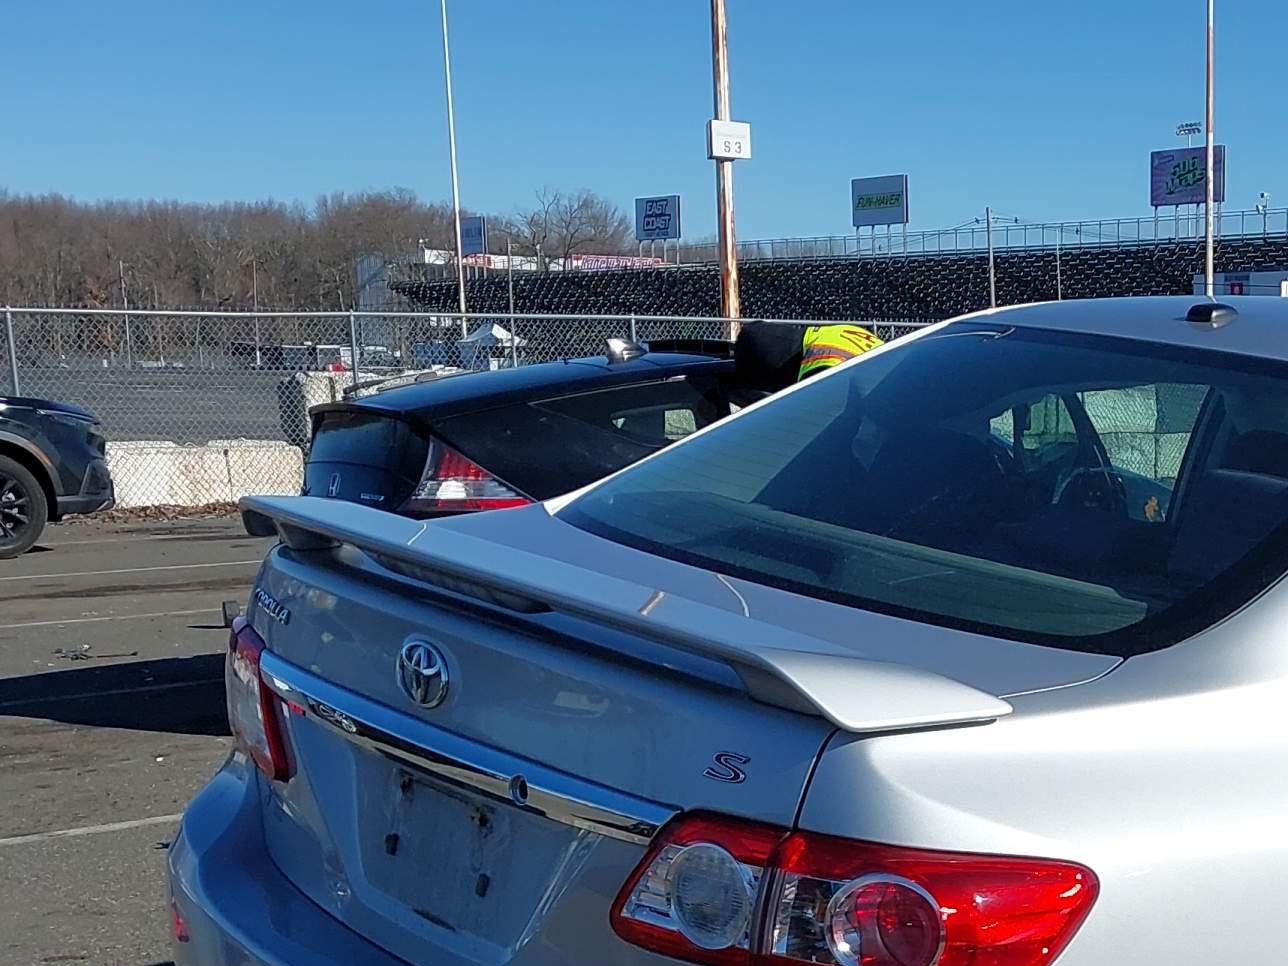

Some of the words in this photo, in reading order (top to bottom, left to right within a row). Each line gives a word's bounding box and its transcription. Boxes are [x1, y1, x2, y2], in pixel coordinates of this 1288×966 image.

[646, 200, 668, 215] EAST
[644, 215, 671, 231] COAST
[703, 750, 751, 784] S
